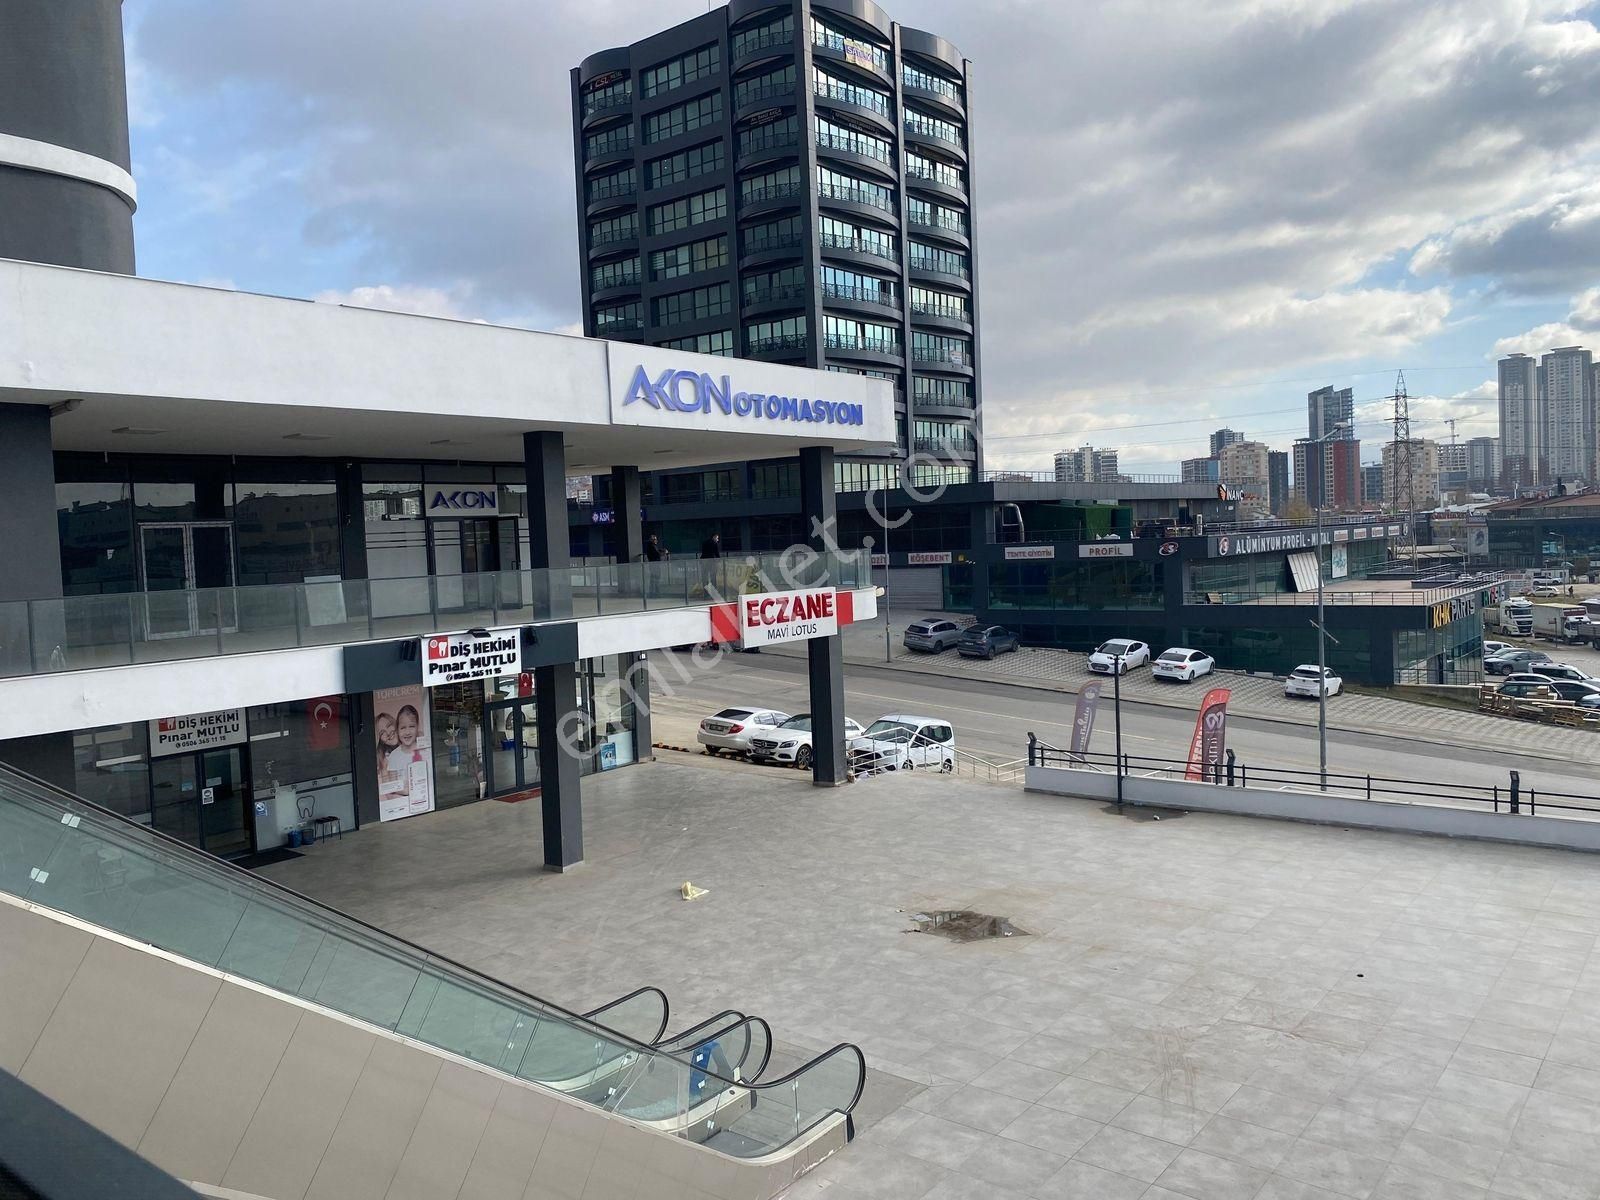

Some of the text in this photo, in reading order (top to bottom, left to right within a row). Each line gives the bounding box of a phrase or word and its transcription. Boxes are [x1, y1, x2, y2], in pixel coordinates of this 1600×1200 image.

[622, 364, 864, 426] AKON OTOMASYON
[429, 491, 496, 509] AKON
[1088, 545, 1123, 556] PROFİL
[1235, 535, 1281, 555] ALÜMİNYUM
[1281, 531, 1306, 550] PROFİL
[1311, 532, 1331, 547] MTAL
[910, 553, 949, 565] KÖŞEBENT
[746, 592, 834, 627] ECZANE
[767, 623, 817, 640] MAVİ LOTUS
[450, 636, 516, 657] DİŞ HEKİMİ
[429, 652, 517, 675] Pınar MUTLU
[485, 668, 493, 676] 11
[178, 710, 239, 729] DİŞ HEKİMİ
[159, 723, 240, 744] Pınar MUTLU
